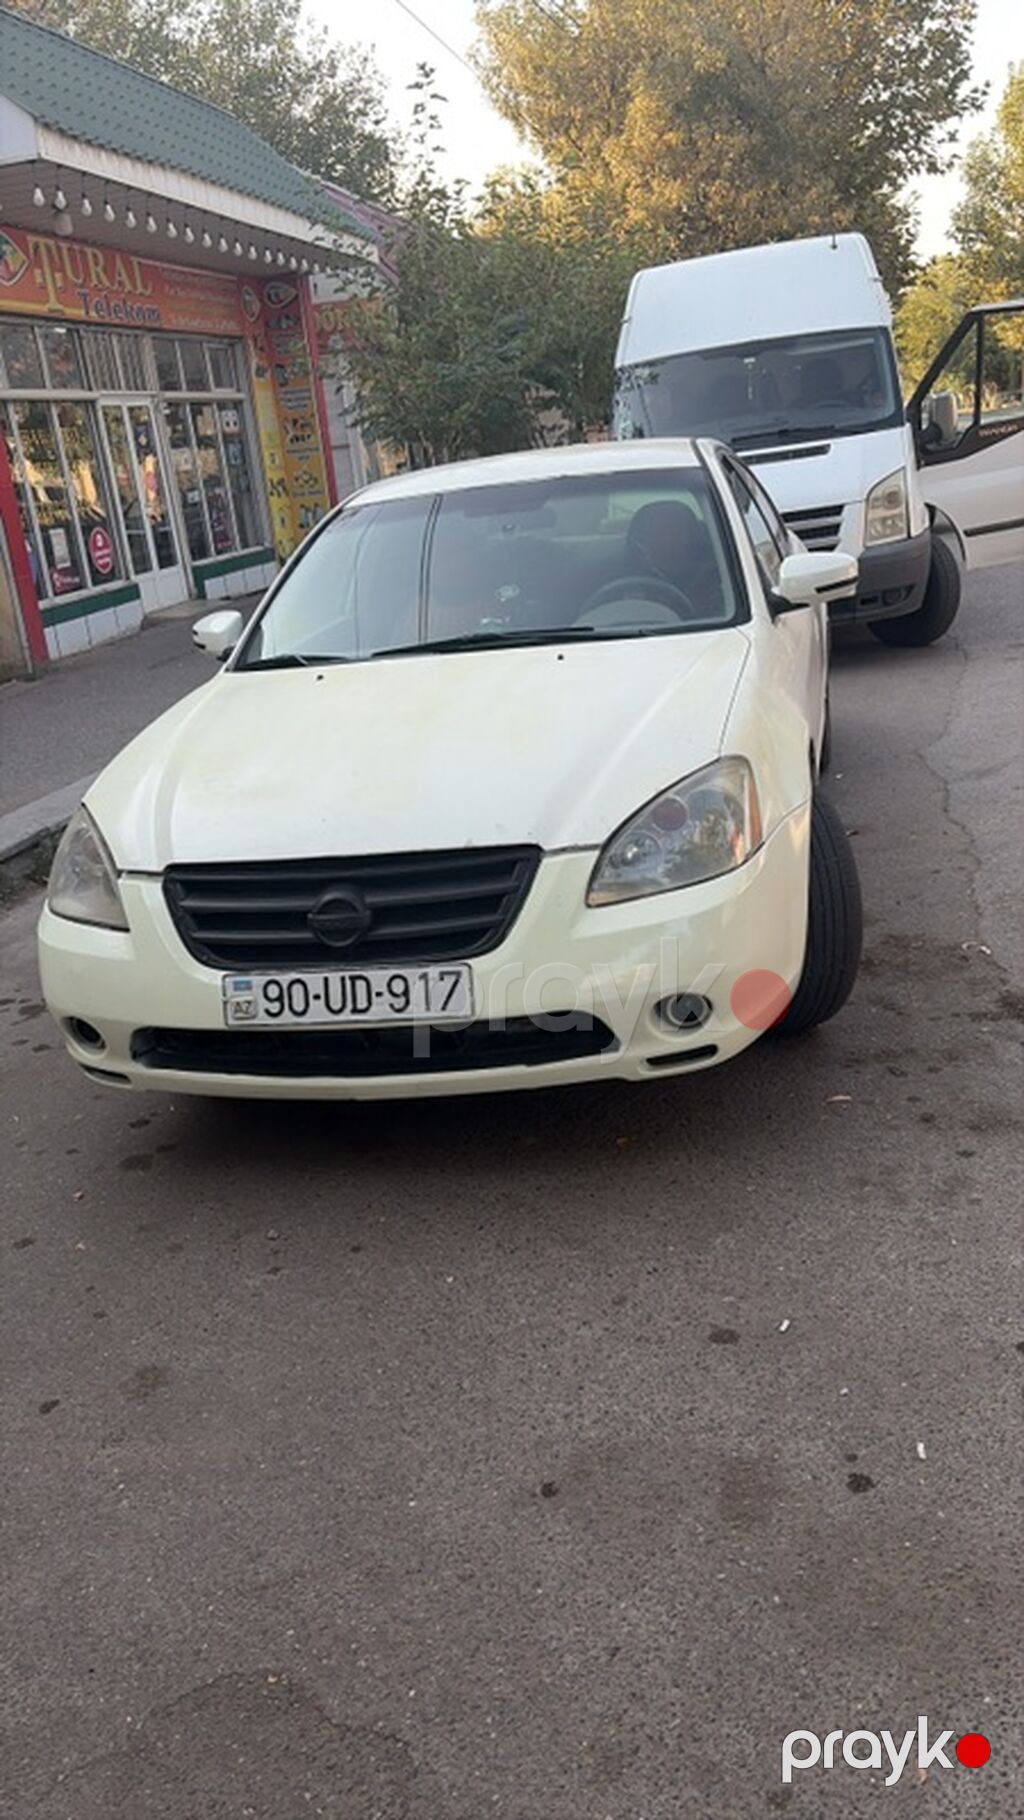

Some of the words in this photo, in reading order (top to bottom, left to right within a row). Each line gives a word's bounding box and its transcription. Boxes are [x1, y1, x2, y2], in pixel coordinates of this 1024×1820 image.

[27, 235, 153, 315] TURAL
[77, 287, 161, 323] Telekom
[232, 1000, 253, 1017] AZ
[262, 970, 463, 1019] 90-UD-917
